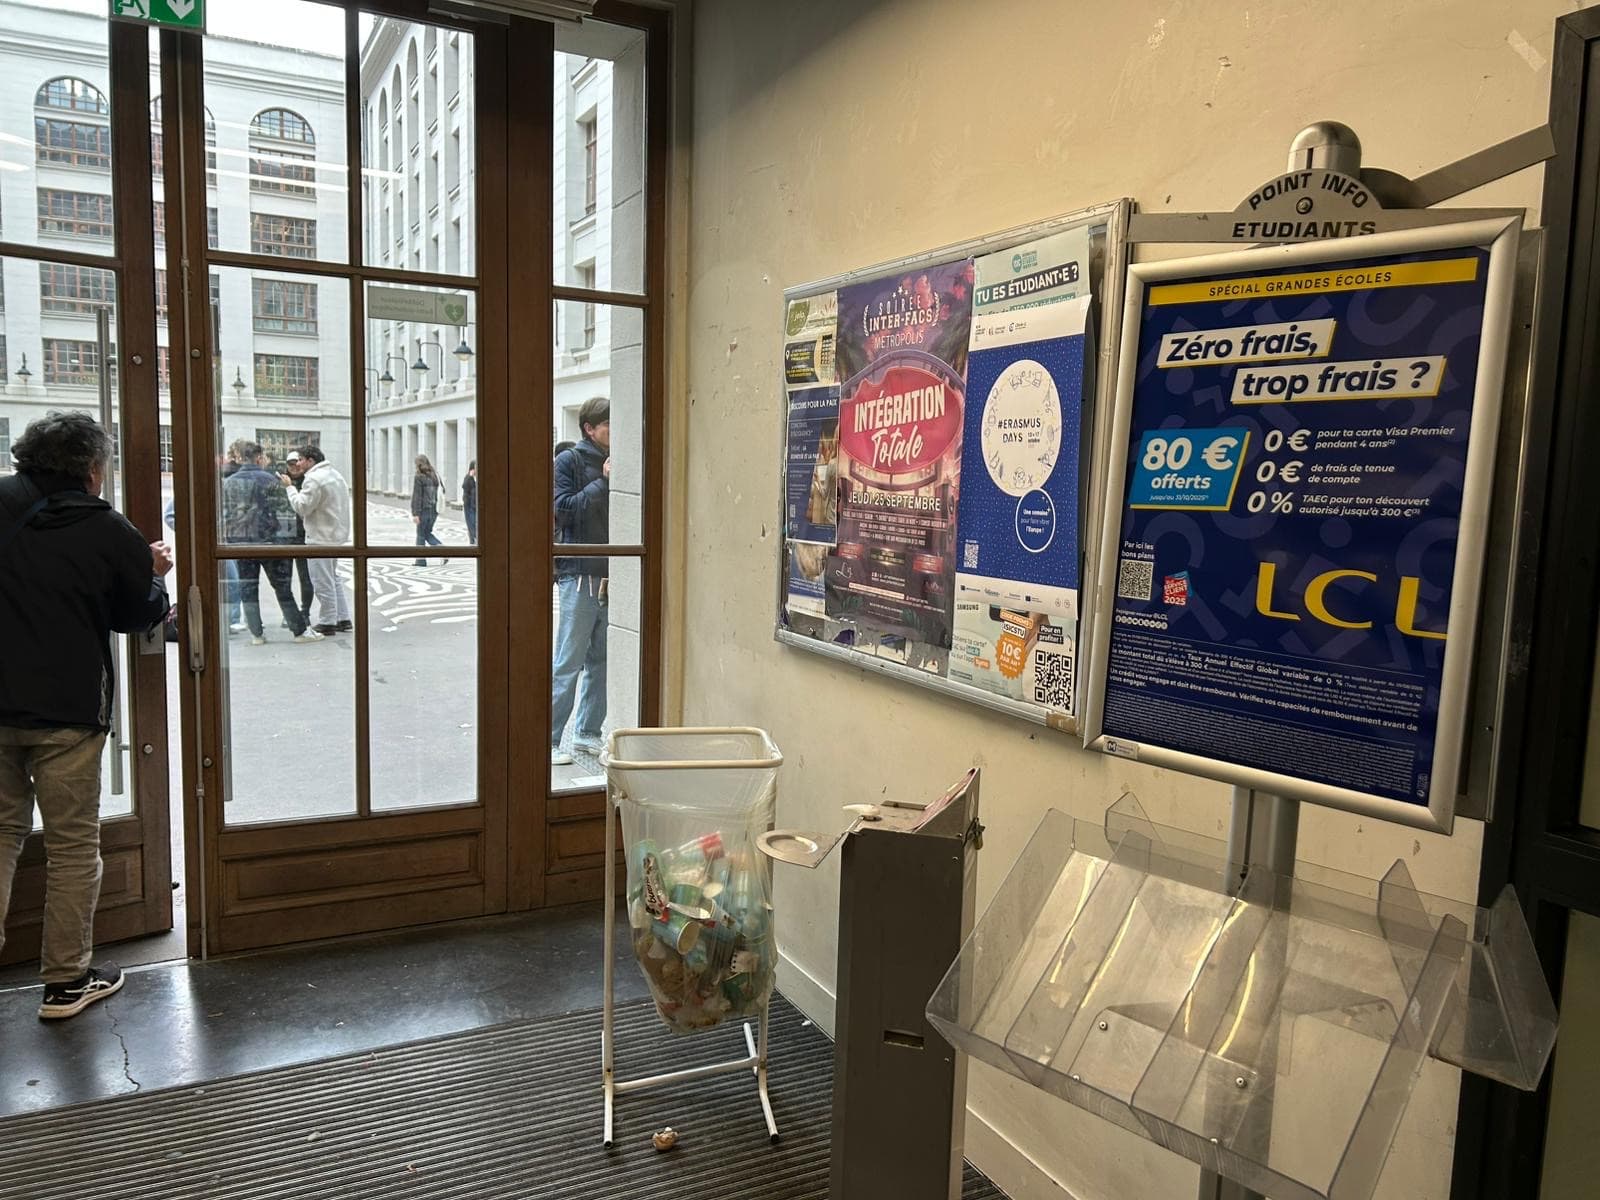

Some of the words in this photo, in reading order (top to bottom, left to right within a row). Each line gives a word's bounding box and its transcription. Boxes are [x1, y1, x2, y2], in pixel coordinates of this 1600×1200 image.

[1249, 173, 1312, 210] POINT
[1321, 173, 1368, 208] INFO
[1232, 221, 1376, 238] ETUDIANTS
[977, 289, 990, 304] TU
[992, 286, 1006, 300] ES
[1071, 265, 1078, 279] ?
[1209, 283, 1260, 296] SPÉCIAL
[1266, 278, 1330, 292] GRANDES
[1335, 272, 1392, 287] ÉCOLES
[869, 308, 933, 332] INTER-FACS
[1166, 335, 1233, 362] Zéro
[1240, 324, 1318, 356] frais,
[1242, 373, 1309, 400] trop
[1317, 361, 1398, 393] frais
[1409, 361, 1431, 388] ?
[854, 383, 945, 433] INTÉGRATION
[998, 418, 1041, 429] #ERASMUS
[1317, 429, 1341, 439] pour
[1343, 429, 1354, 437] ta
[1355, 428, 1383, 437] carte
[1385, 426, 1408, 436] Visa
[1410, 425, 1455, 436] Premier
[871, 425, 923, 468] Totale
[1003, 432, 1023, 443] DAYS
[1264, 429, 1283, 452] 0
[1287, 428, 1312, 452] €
[1314, 440, 1357, 450] pendant
[1359, 440, 1367, 448] 4
[1142, 437, 1192, 470] 80
[1201, 436, 1239, 470] €
[1256, 461, 1276, 483] 0
[1279, 460, 1304, 483] €
[1311, 464, 1323, 472] de
[1325, 463, 1347, 472] frais
[1349, 464, 1362, 472] de
[1365, 464, 1396, 473] tenue
[1151, 473, 1212, 489] offerts
[1308, 475, 1320, 483] de
[1322, 476, 1361, 485] compte
[848, 491, 872, 504] JEUDI
[874, 494, 885, 506] 25
[886, 494, 941, 511] SEPTEMBRE
[1247, 491, 1265, 514] 0
[1270, 491, 1294, 514] %
[1303, 494, 1328, 503] TAEG
[1329, 496, 1353, 505] pour
[1355, 496, 1373, 505] ton
[1375, 495, 1430, 506] découvert
[1299, 505, 1339, 515] autorisé
[1380, 508, 1401, 517] 300
[1122, 550, 1136, 558] bons
[1137, 552, 1154, 560] plans
[1136, 541, 1144, 549] ici
[1145, 542, 1154, 550] les
[1164, 596, 1186, 606] 2025
[1256, 562, 1447, 640] LCL
[1002, 641, 1013, 657] 10
[1013, 647, 1022, 661] €
[1118, 649, 1141, 658] montant
[1191, 661, 1203, 669] 300
[1204, 657, 1227, 666] Annuel
[1256, 666, 1279, 675] Global
[1281, 671, 1310, 680] variable
[1313, 675, 1323, 683] de
[1118, 669, 1135, 678] crédit
[1148, 676, 1170, 686] engage
[1190, 683, 1202, 691] être
[1239, 692, 1264, 703] Vérifiez
[1264, 698, 1276, 706] vos
[1277, 701, 1310, 712] capacités
[1311, 706, 1320, 714] de
[1321, 710, 1381, 725] remboursement
[1382, 720, 1406, 729] avant
[1407, 723, 1418, 731] de
